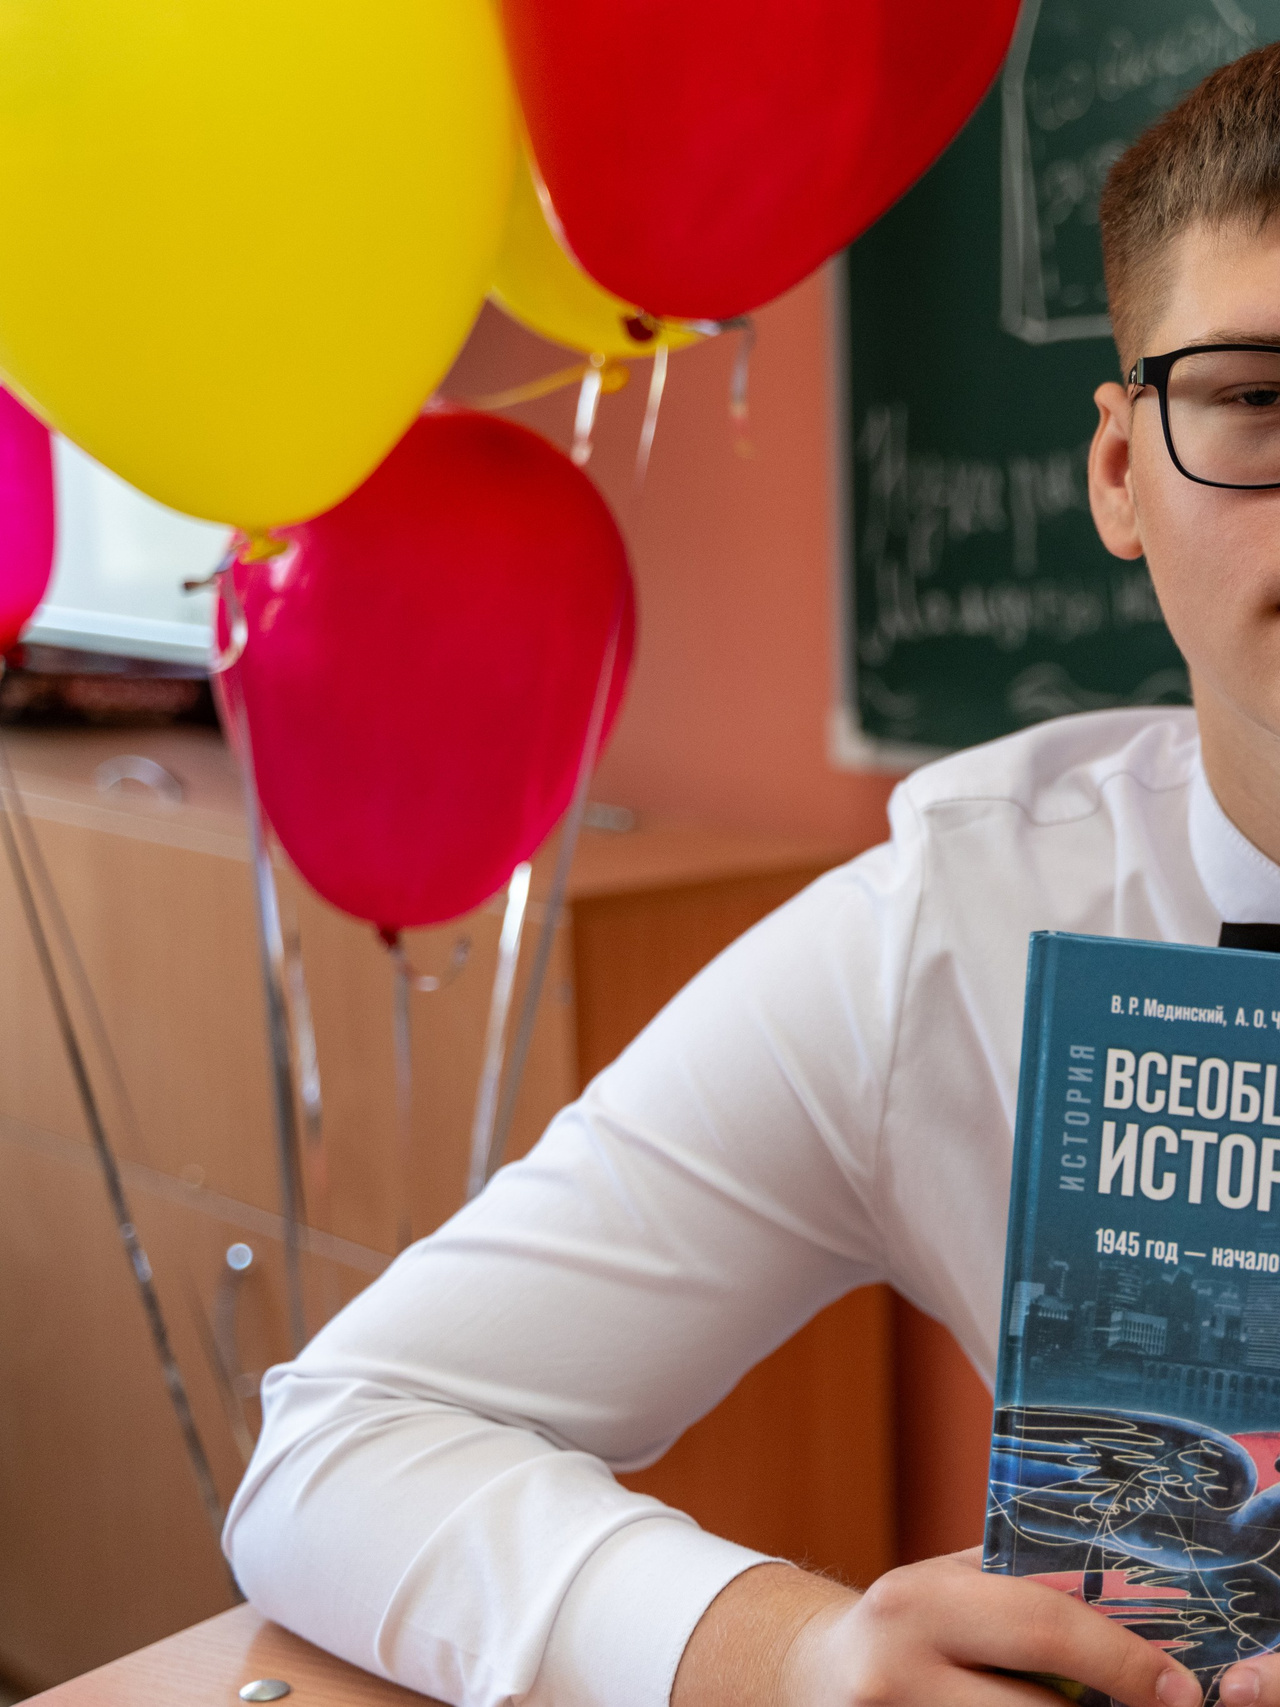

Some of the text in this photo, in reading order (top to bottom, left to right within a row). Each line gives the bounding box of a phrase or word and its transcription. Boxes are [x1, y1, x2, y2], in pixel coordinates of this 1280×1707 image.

[1110, 995, 1125, 1015] В.
[1128, 997, 1140, 1017] Р.
[1143, 998, 1228, 1027] Мединский,
[1235, 1007, 1250, 1027] А.
[1253, 1009, 1267, 1029] О.
[1059, 1045, 1095, 1192] ИСТОРИЯ
[1095, 1228, 1140, 1257] 1945
[1145, 1237, 1179, 1264] год
[1211, 1247, 1280, 1273] начало
